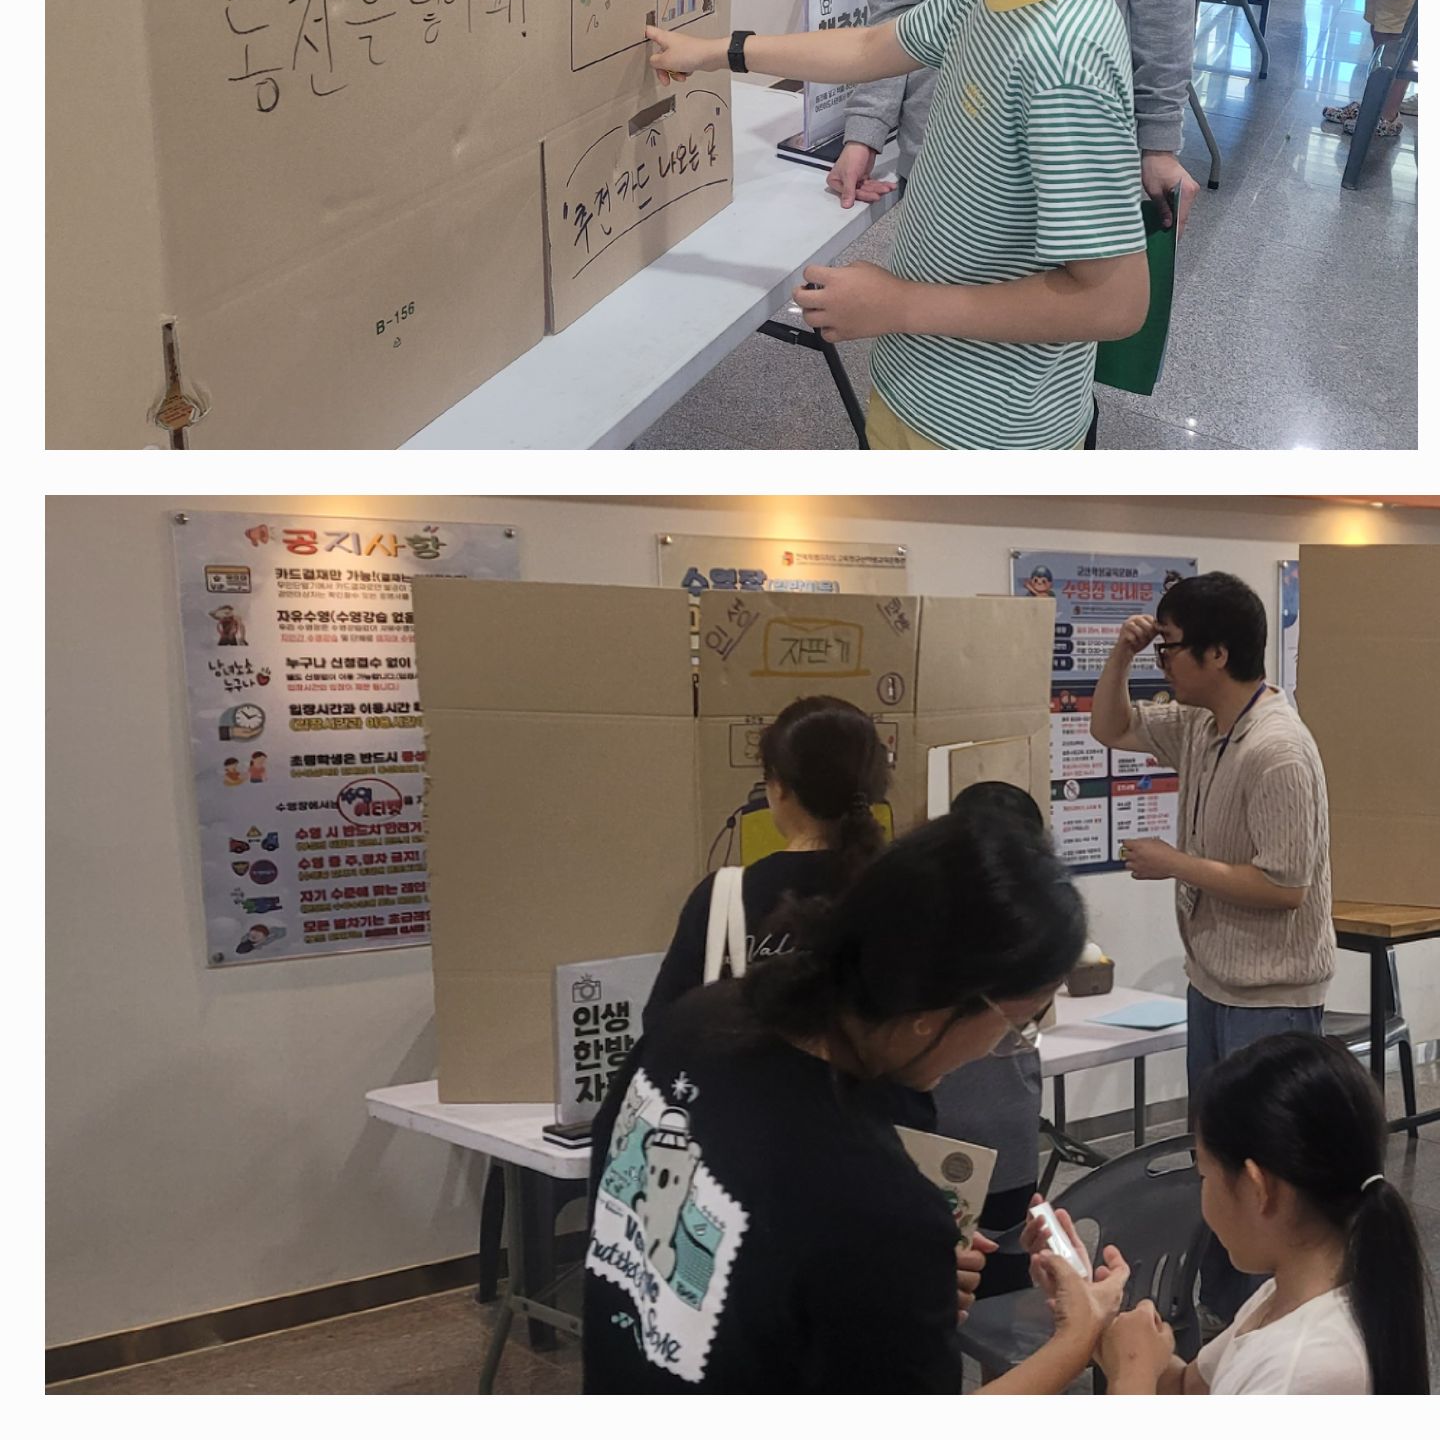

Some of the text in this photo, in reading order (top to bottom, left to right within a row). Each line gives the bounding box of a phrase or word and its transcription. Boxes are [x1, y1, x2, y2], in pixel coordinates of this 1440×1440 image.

[615, 163, 653, 210] 카드
[658, 133, 700, 178] 나오는
[374, 301, 417, 338] B-156
[282, 525, 447, 560] 공지사항
[705, 597, 751, 656] 인생
[286, 657, 326, 669] 누구나
[386, 657, 411, 669] 없이
[779, 637, 850, 666] 자판기
[289, 702, 410, 715] 입장시간과 이용시간
[360, 751, 398, 764] 반드시
[296, 828, 321, 839] 수영
[326, 826, 338, 838] 시
[298, 857, 324, 869] 수영
[300, 890, 327, 902] 자기
[572, 1001, 631, 1038] 인생
[573, 1035, 635, 1071] 한방
